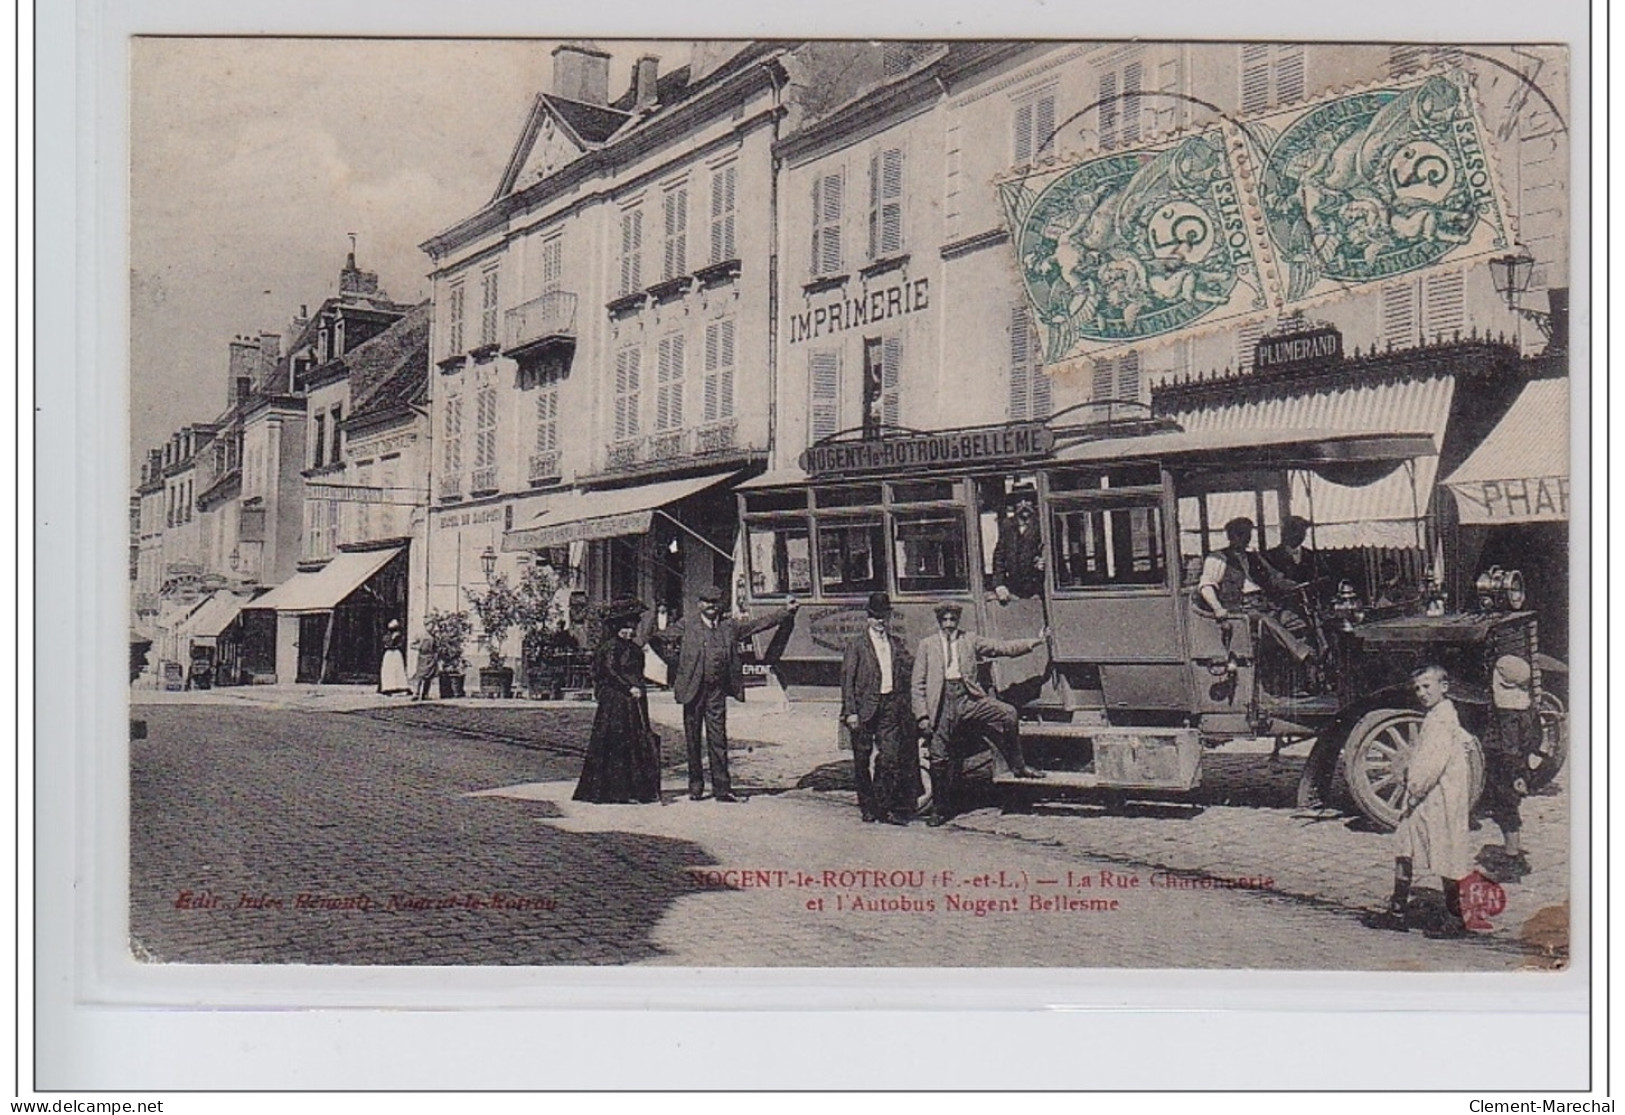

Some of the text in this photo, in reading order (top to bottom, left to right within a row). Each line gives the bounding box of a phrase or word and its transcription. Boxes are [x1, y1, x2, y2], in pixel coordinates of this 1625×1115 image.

[1456, 121, 1493, 199] POSTES
[1215, 181, 1251, 264] POSTES
[790, 277, 929, 344] IMPRIMERIE
[1259, 334, 1336, 366] PLUMERAND
